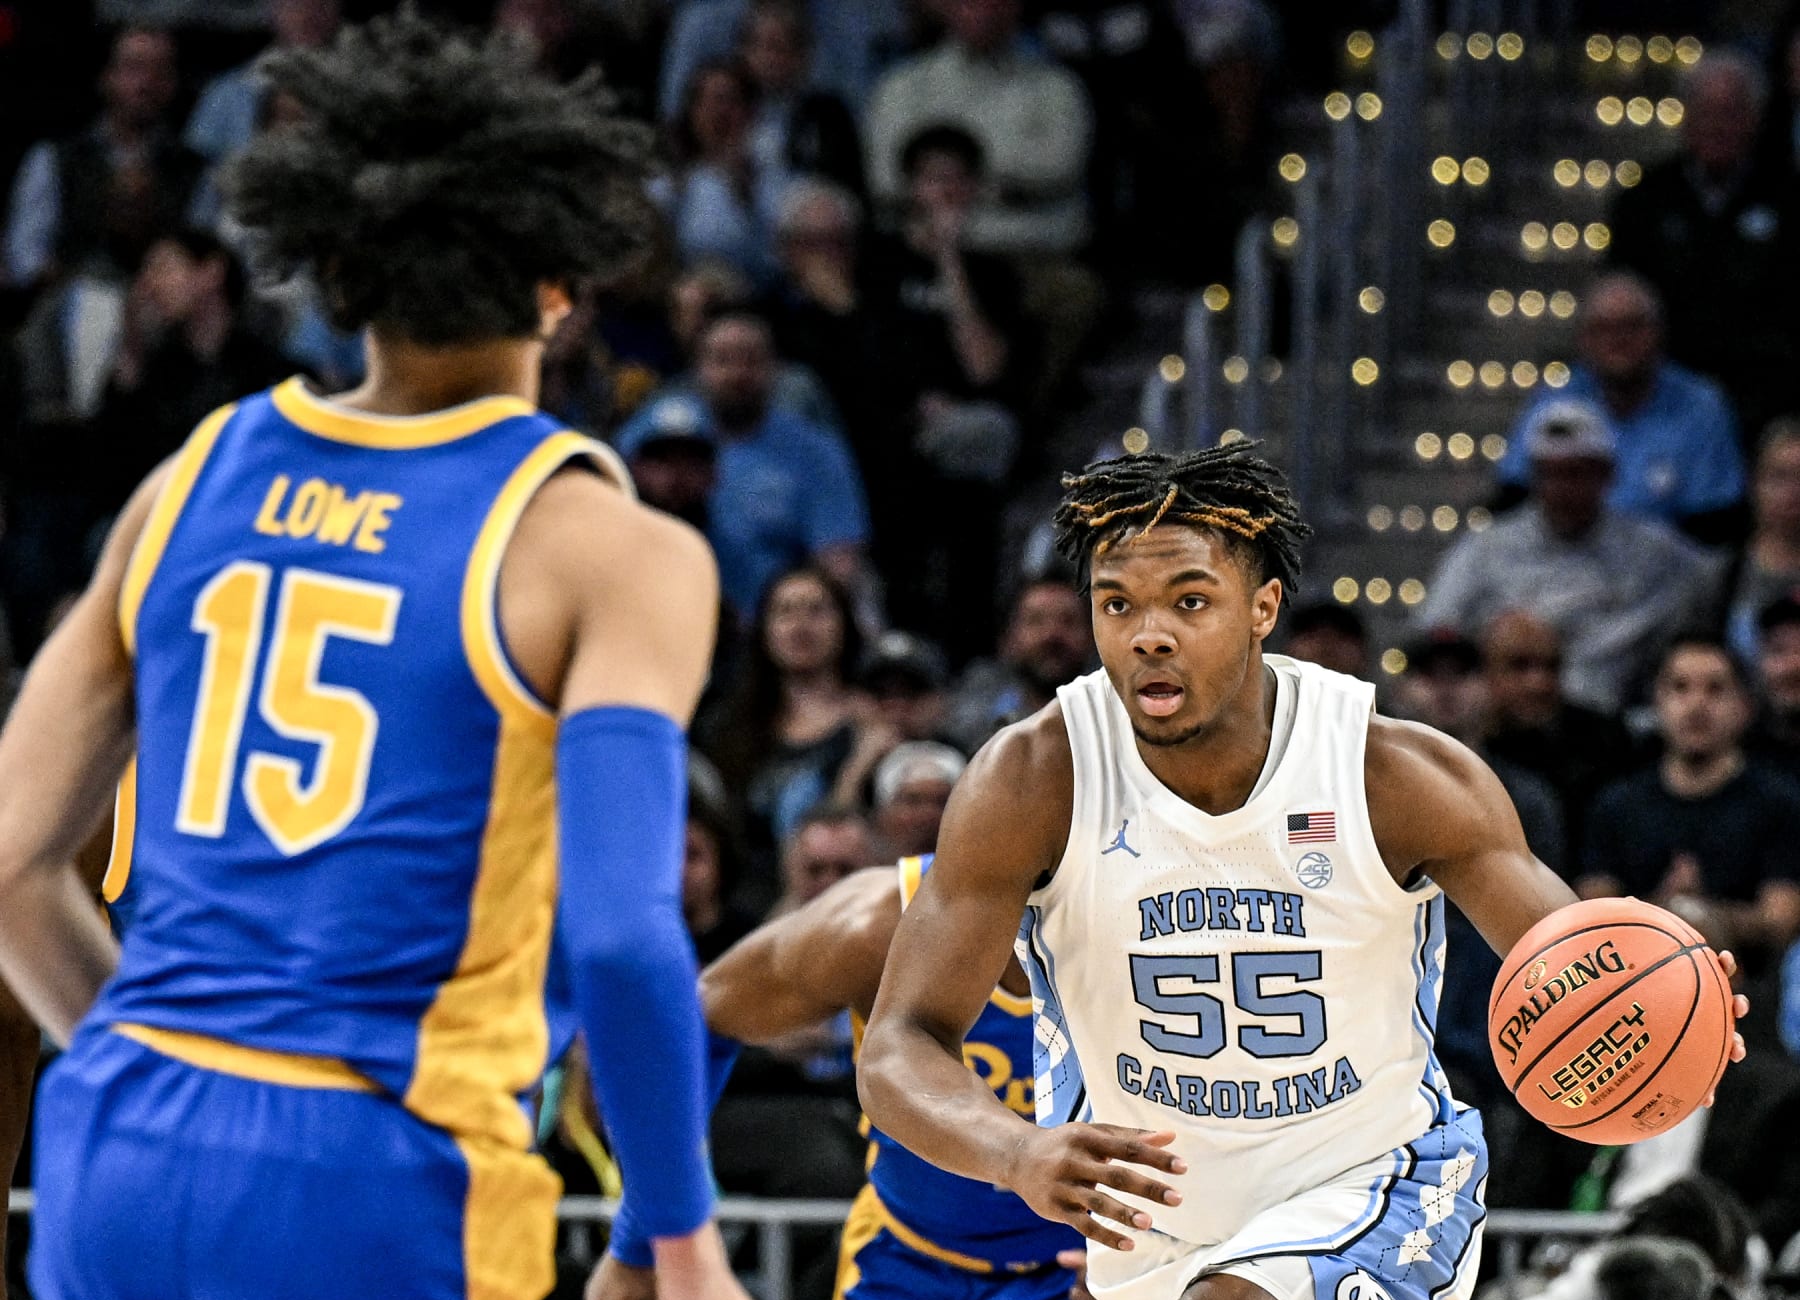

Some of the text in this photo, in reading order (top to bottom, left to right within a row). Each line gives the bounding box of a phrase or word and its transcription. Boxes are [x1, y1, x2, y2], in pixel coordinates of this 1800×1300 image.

[254, 474, 403, 553] LOWE
[174, 559, 404, 857] 15
[1138, 887, 1306, 941] NORTH
[1128, 950, 1328, 1059] 55
[1498, 940, 1626, 1065] SPALDING
[1117, 1053, 1362, 1119] CAROLINA
[1537, 1002, 1646, 1101] LEGACY
[1585, 1032, 1650, 1093] 1000
